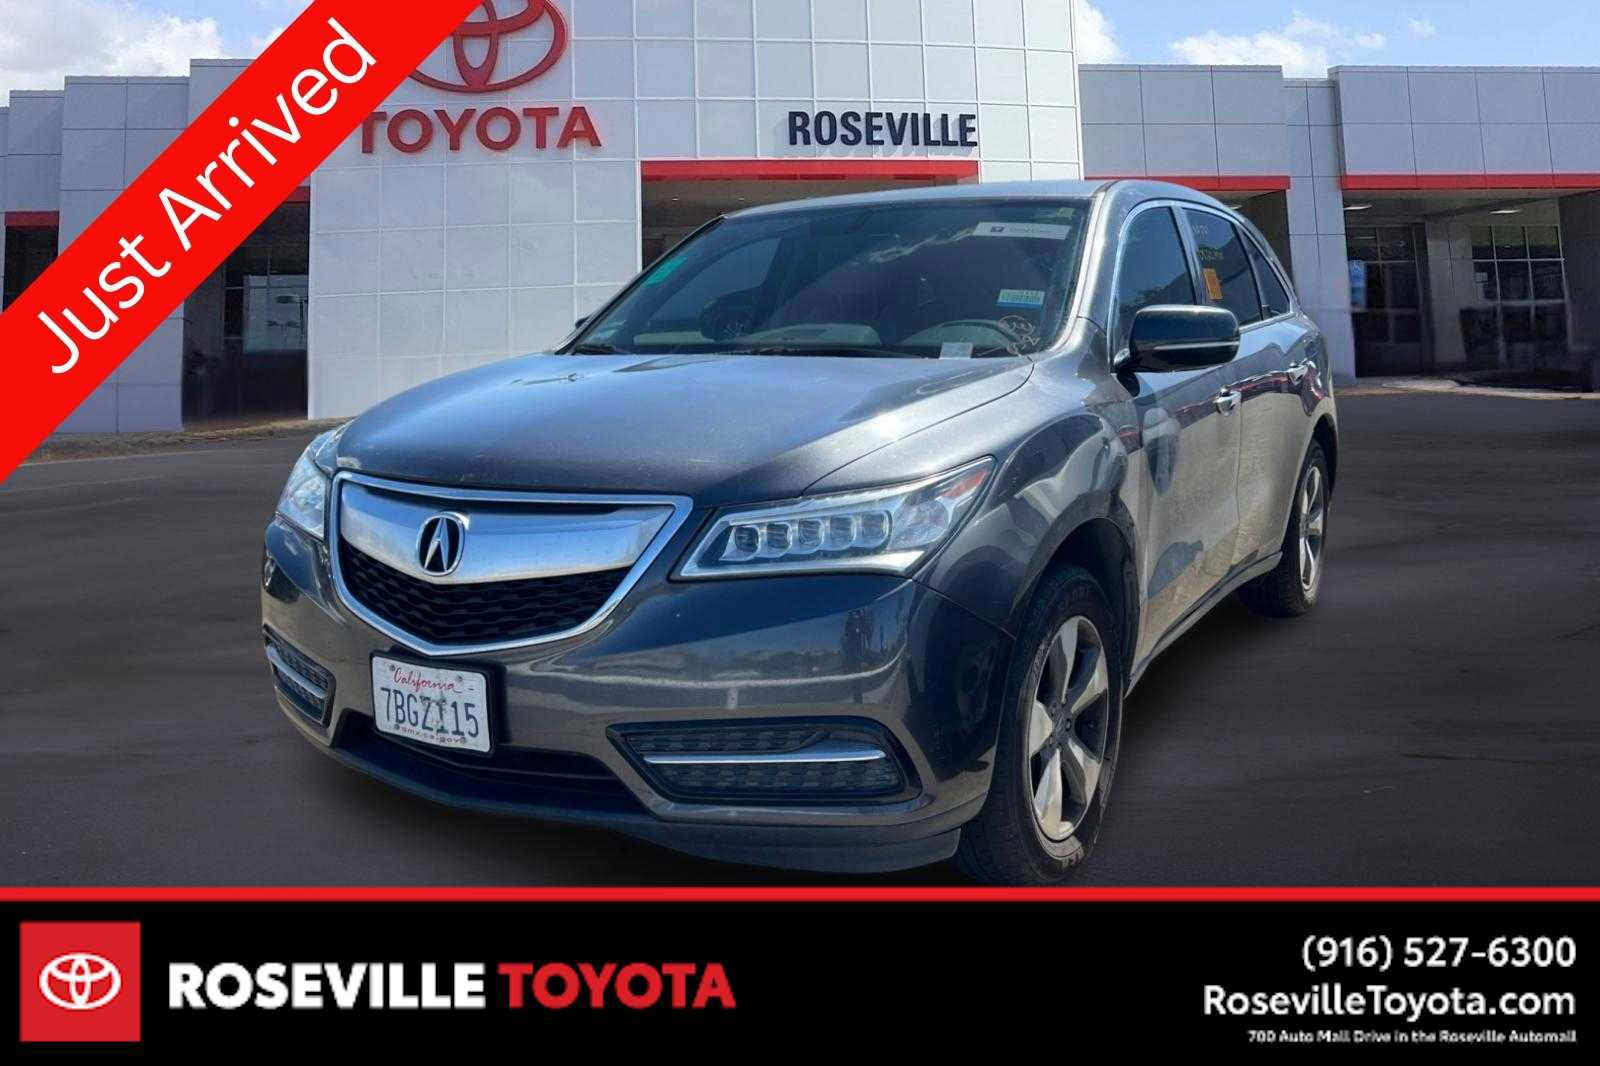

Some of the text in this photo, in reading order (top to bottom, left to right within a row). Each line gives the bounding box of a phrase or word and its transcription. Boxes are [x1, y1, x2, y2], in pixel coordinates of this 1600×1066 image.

[360, 106, 602, 154] TOYOTA
[789, 111, 977, 147] ROSEVILLE
[393, 667, 462, 692] California
[380, 687, 479, 738] 7BGZ115
